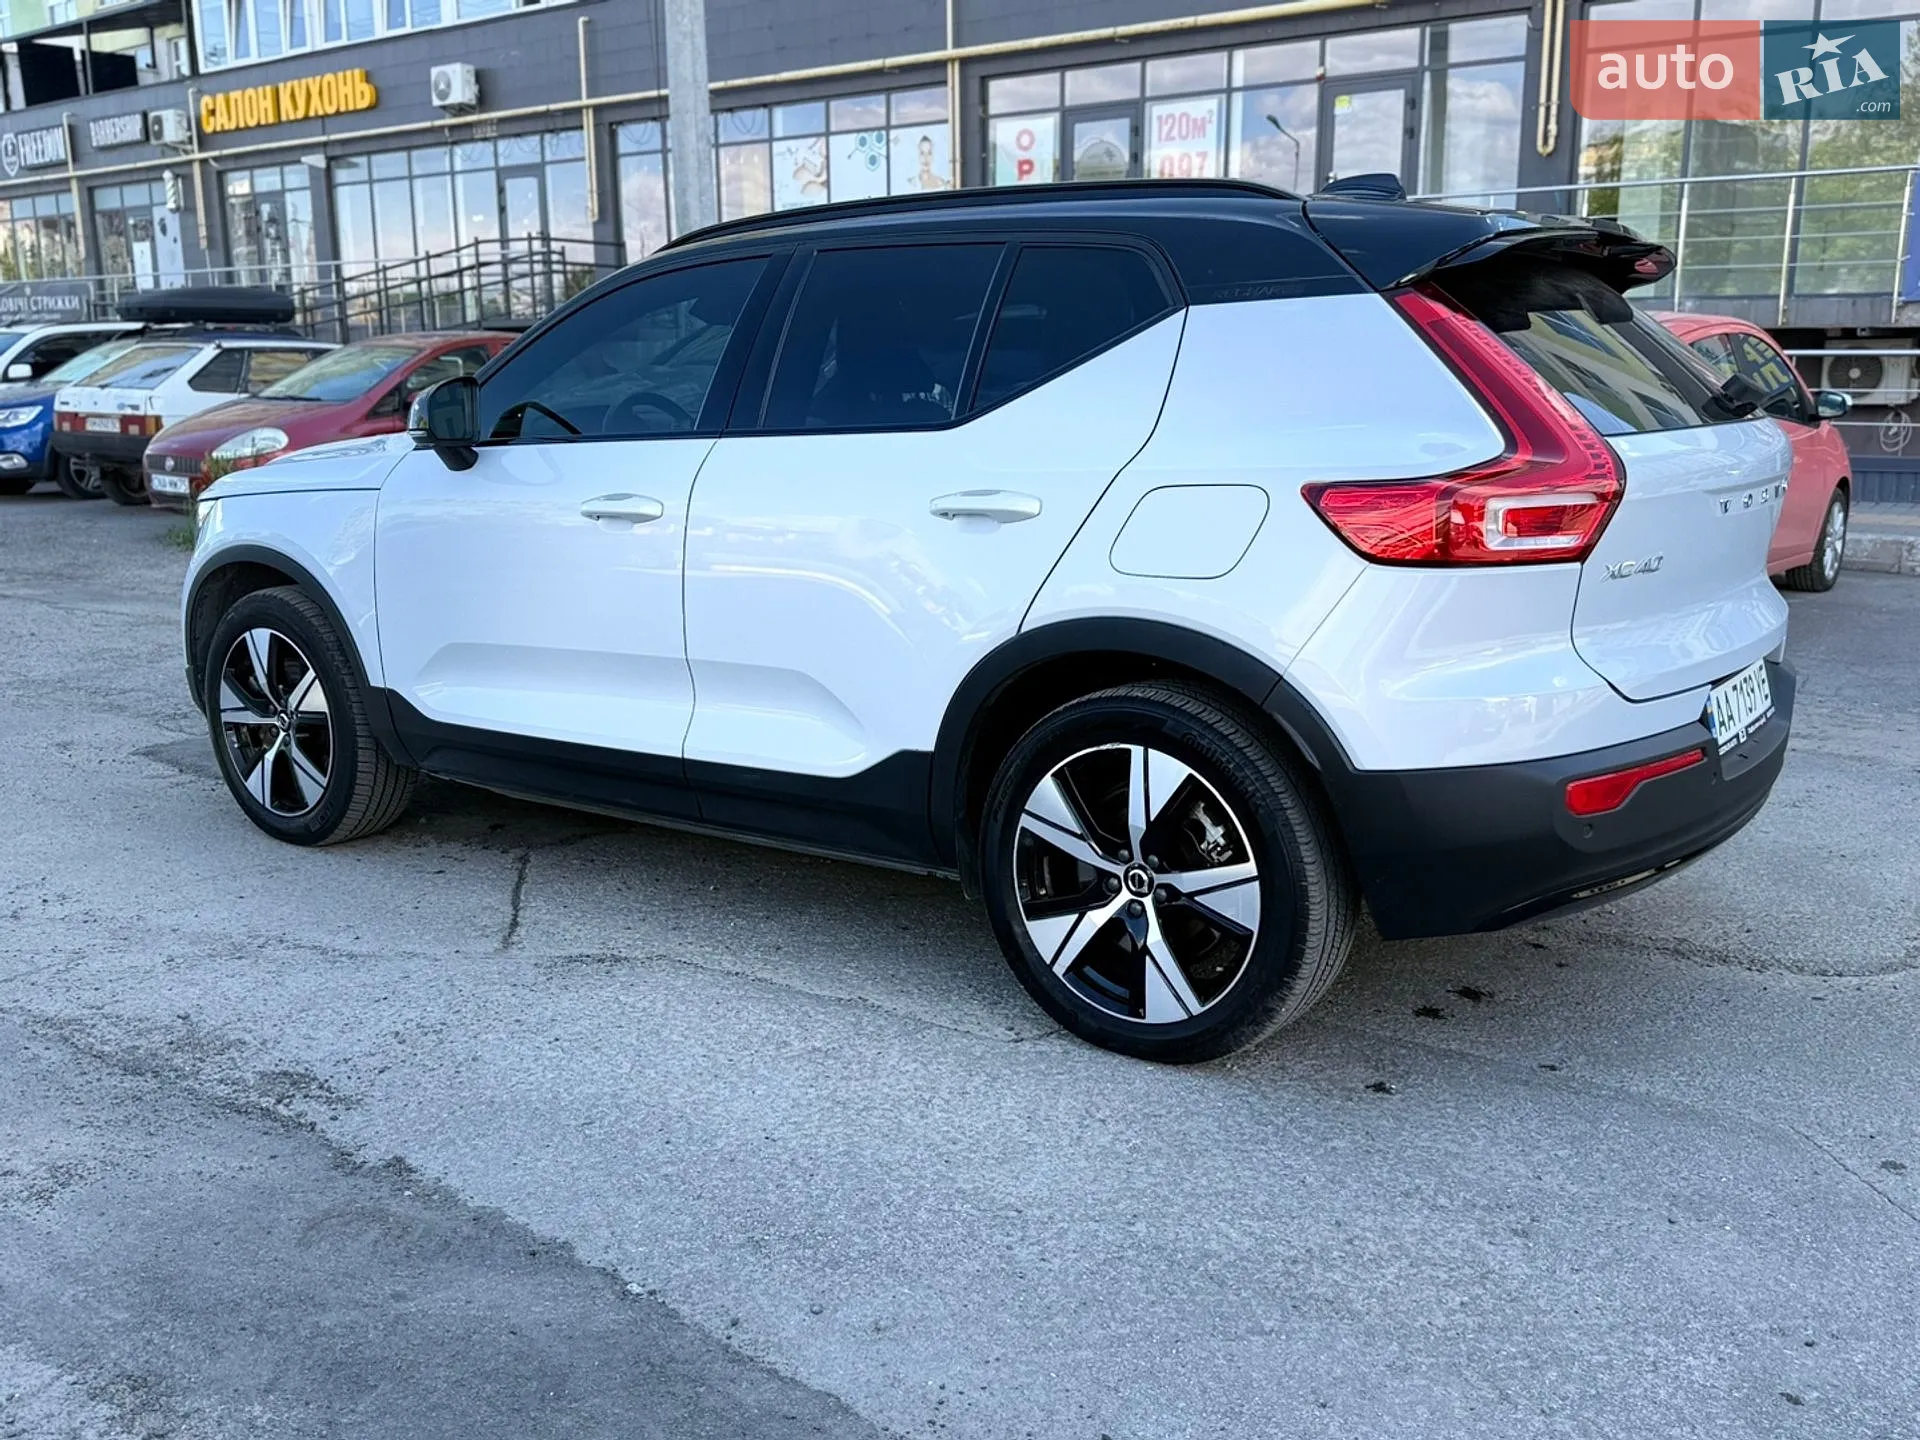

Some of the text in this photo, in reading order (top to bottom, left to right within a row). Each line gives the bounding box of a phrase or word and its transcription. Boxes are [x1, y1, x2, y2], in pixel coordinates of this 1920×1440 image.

[201, 68, 376, 134] САЛОН КУХОНЬ
[17, 126, 66, 168] FREEDOM
[30, 295, 80, 312] СТРИЖКИ
[1600, 553, 1664, 583] XC40
[1716, 689, 1737, 737] AA
